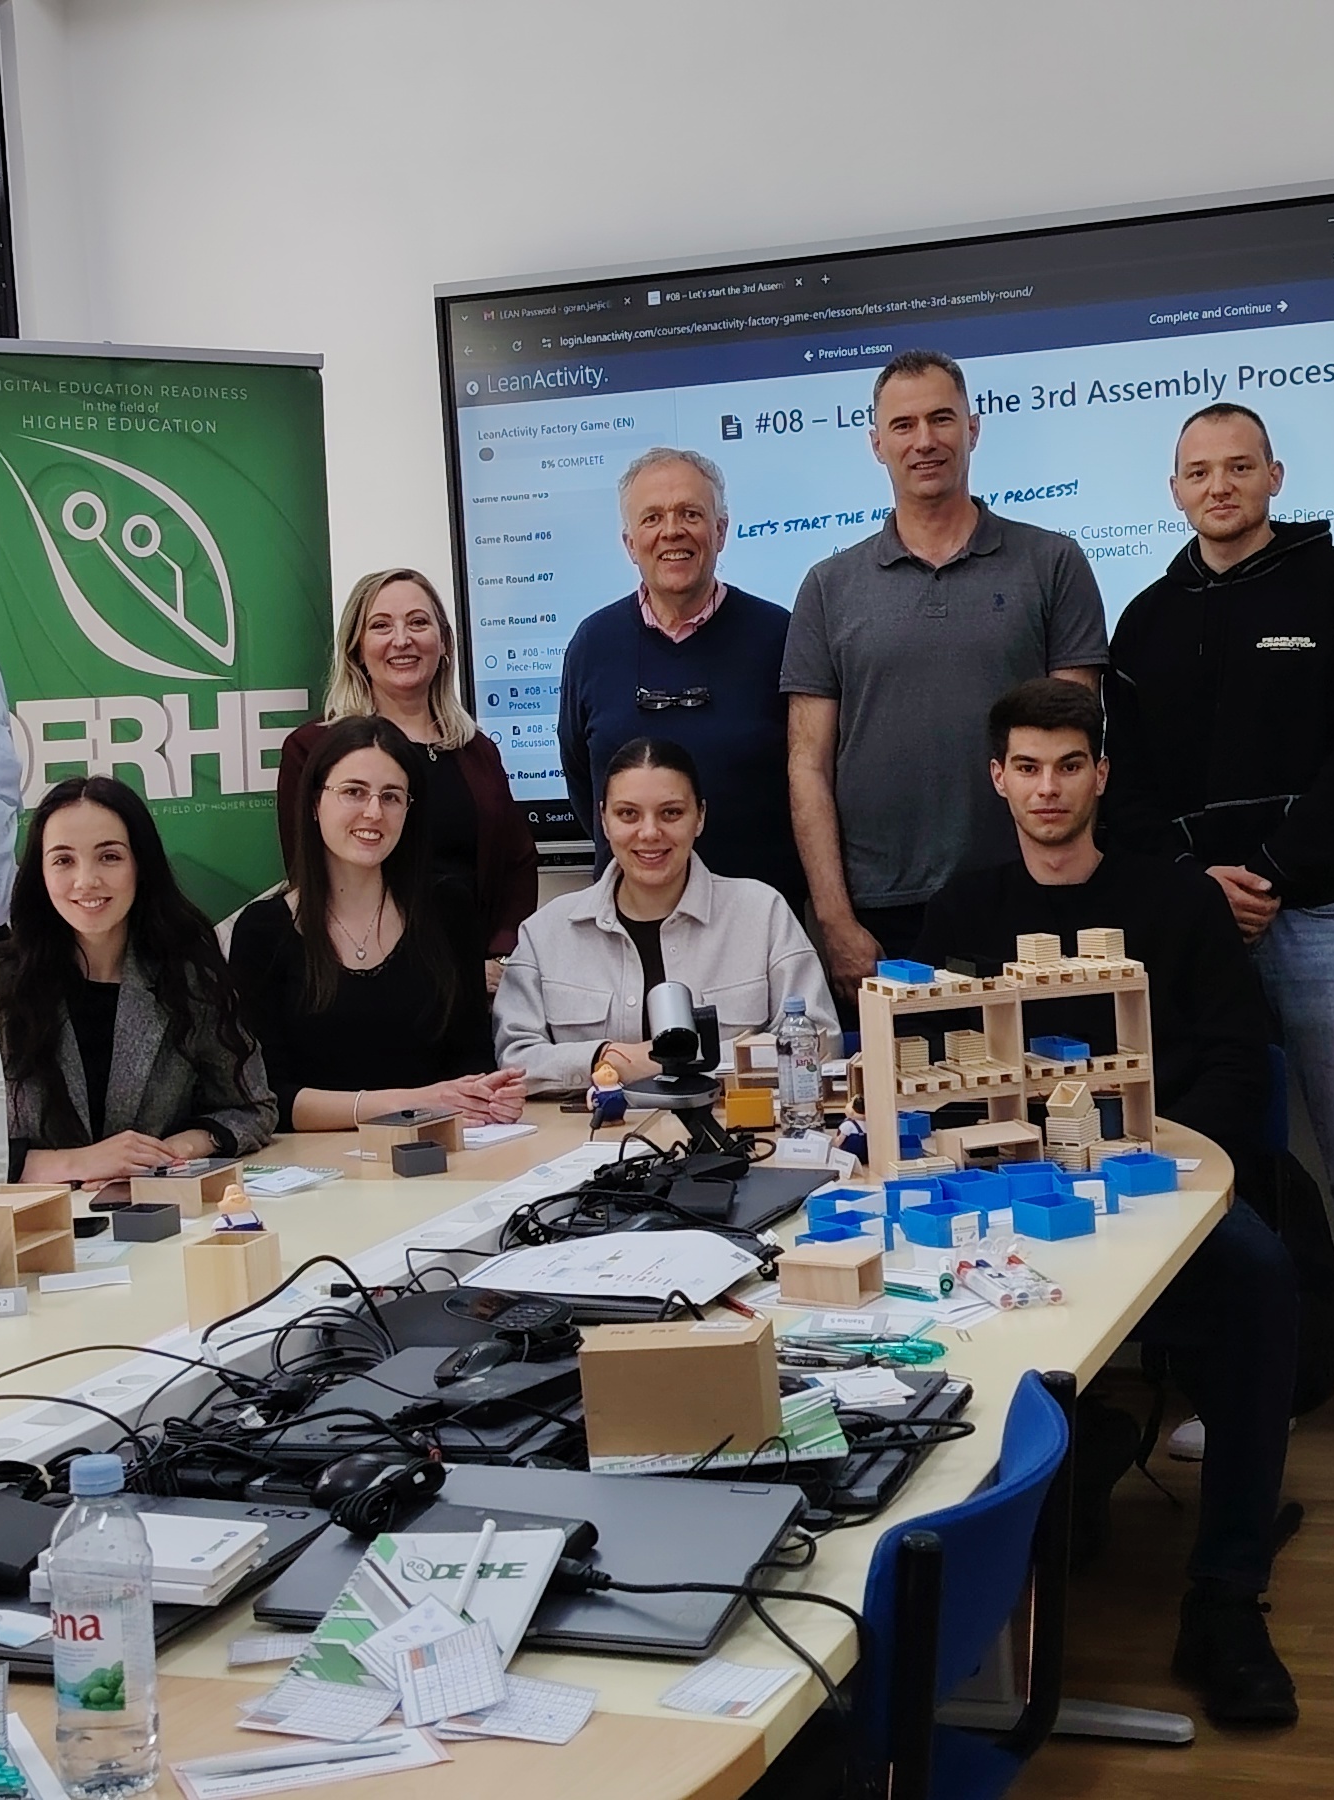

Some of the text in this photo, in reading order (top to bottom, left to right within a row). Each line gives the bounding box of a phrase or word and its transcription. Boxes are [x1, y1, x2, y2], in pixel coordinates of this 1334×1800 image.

[666, 292, 681, 301] #08
[688, 289, 707, 299] Let's
[708, 287, 727, 298] start
[728, 285, 741, 295] the
[742, 283, 756, 294] 3rd
[500, 310, 520, 320] LEAN
[521, 305, 557, 317] Password
[1148, 302, 1272, 326] Complete and Continue
[818, 342, 893, 360] Previous Lesson
[487, 364, 609, 394] LeanActivity.
[58, 381, 154, 397] EDUCATION
[160, 385, 249, 400] READINESS
[97, 401, 117, 412] the
[119, 401, 145, 413] field
[147, 402, 160, 413] of
[754, 408, 804, 435] #08
[836, 405, 875, 430] Let
[975, 388, 1021, 416] the
[1030, 381, 1077, 411] 3rd
[1086, 368, 1228, 406] Assembly
[22, 415, 217, 434] HIGHER EDUCATION
[477, 417, 635, 441] LeanActivity Factory Game (EN)
[557, 455, 605, 468] COMPLETE
[835, 511, 865, 528] THE
[474, 531, 552, 545] Game Round #06
[1058, 527, 1077, 539] he
[1080, 522, 1154, 540] Customer
[1083, 540, 1153, 562] opwatch.
[477, 572, 554, 586] Game Round #07
[480, 614, 557, 627] Game Round #08
[522, 647, 539, 657] #08
[506, 661, 553, 672] Piece-Flow
[524, 686, 541, 696] #08
[548, 686, 562, 696] Let
[508, 700, 541, 711] Process
[526, 724, 543, 735] #08
[511, 738, 556, 749] Discussion
[517, 769, 547, 780] Round
[163, 805, 191, 815] FIELD
[545, 812, 575, 823] Search
[2, 1299, 8, 1307] 2
